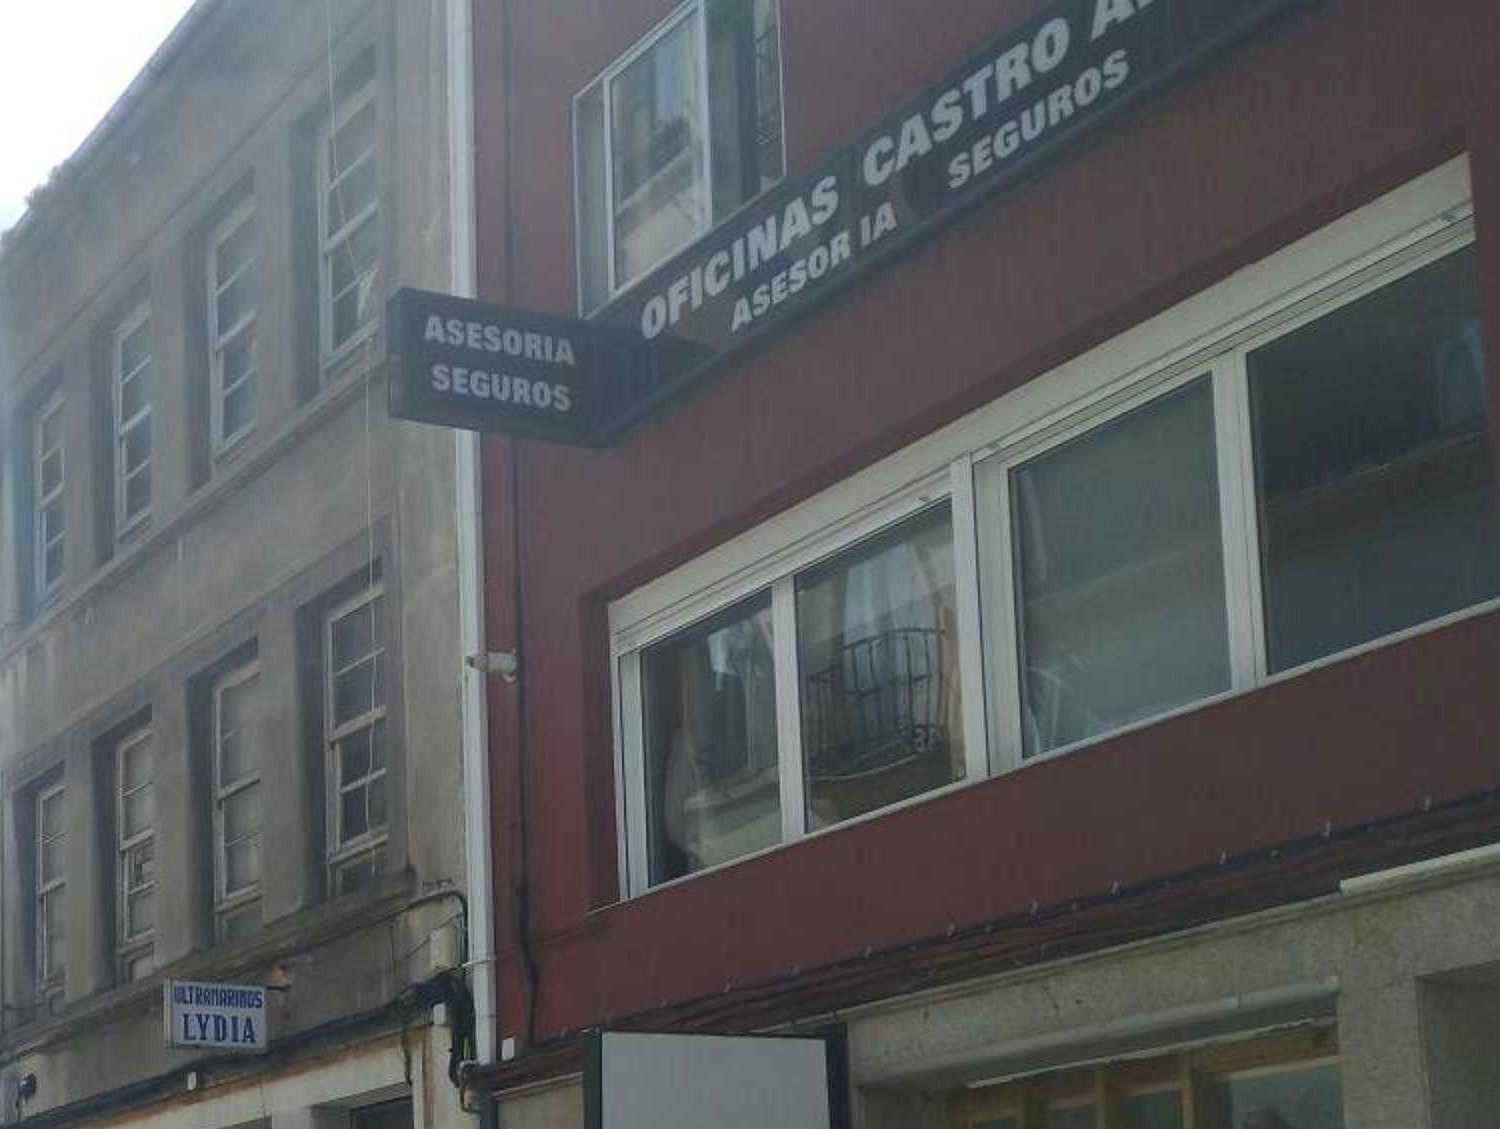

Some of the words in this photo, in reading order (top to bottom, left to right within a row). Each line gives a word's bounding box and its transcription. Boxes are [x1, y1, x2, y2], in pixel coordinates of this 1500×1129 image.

[948, 49, 1129, 189] SEGUROS
[641, 175, 839, 339] OFICINAS
[863, 17, 1070, 187] CASTRO
[1091, 0, 1153, 41] A
[423, 314, 576, 366] ASESORIA
[431, 363, 572, 412] SEGUROS
[173, 984, 263, 1009] ULTRAMARINOS
[182, 1012, 256, 1044] LYDIA
